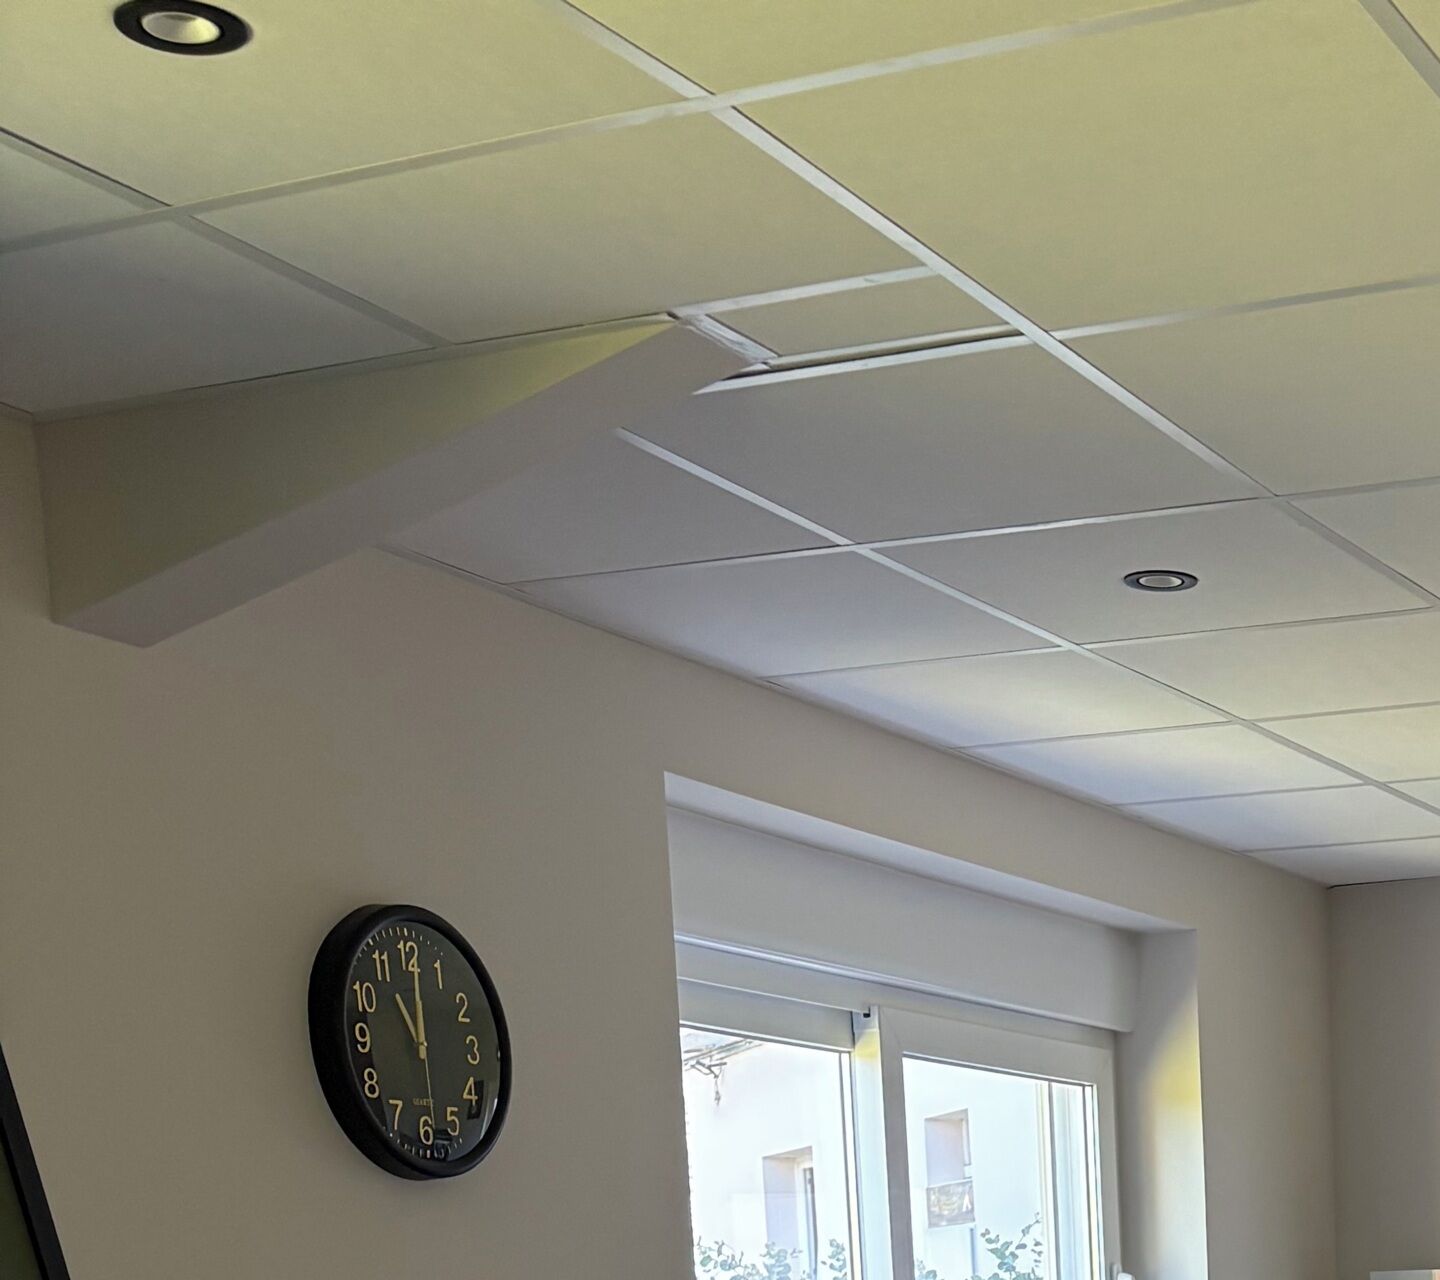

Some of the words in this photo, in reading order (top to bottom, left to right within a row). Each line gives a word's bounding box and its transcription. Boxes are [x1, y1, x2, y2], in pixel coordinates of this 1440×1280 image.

[372, 950, 391, 982] 11
[397, 940, 420, 972] 12
[433, 959, 443, 990] 1
[352, 980, 377, 1013] 10
[456, 992, 470, 1023] 2
[354, 1022, 371, 1053] 9
[465, 1035, 480, 1065] 3
[363, 1068, 380, 1098] 8
[463, 1076, 478, 1105] 4
[388, 1099, 403, 1130] 7
[419, 1115, 434, 1145] 6
[446, 1106, 460, 1136] 5
